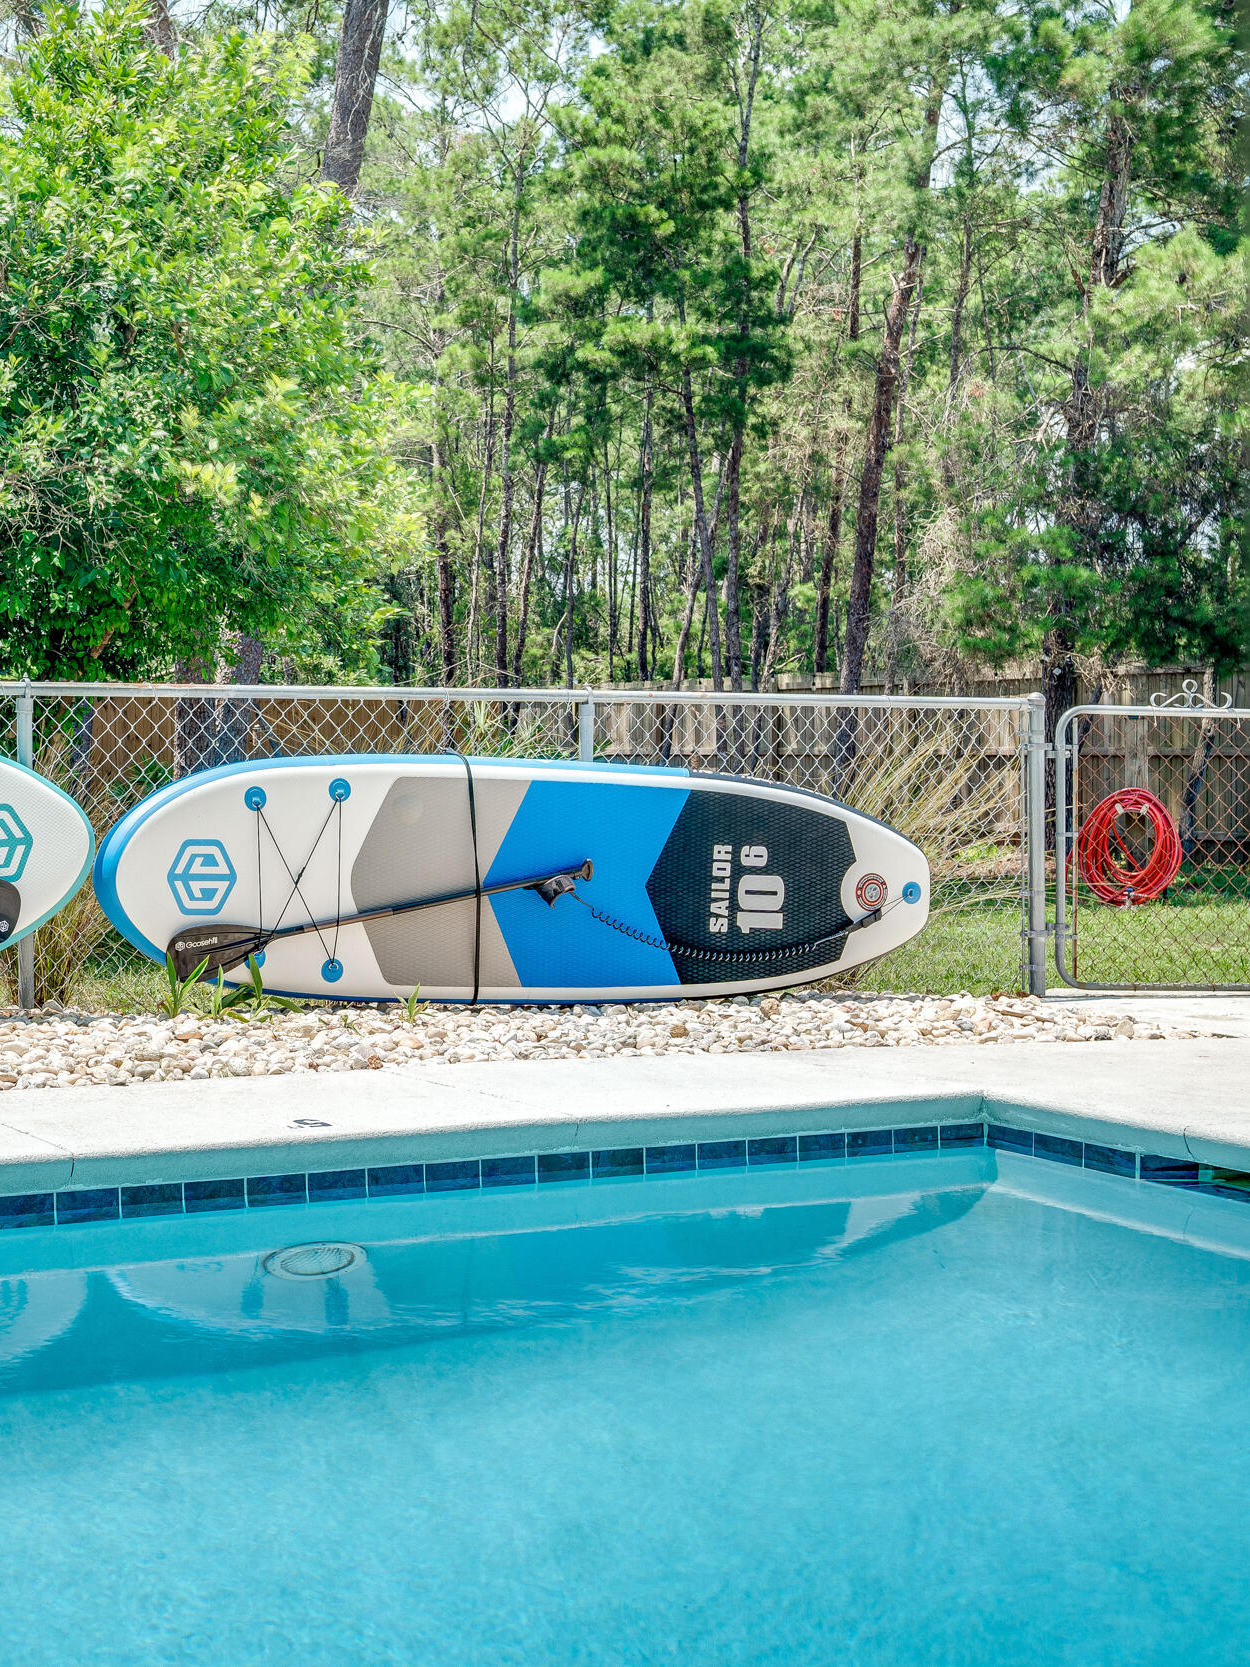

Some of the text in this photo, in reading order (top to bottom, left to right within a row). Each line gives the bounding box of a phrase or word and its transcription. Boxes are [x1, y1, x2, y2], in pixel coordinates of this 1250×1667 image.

[710, 845, 732, 932] SAILOR
[737, 845, 785, 934] 10 6
[186, 937, 218, 948] Goosehill
